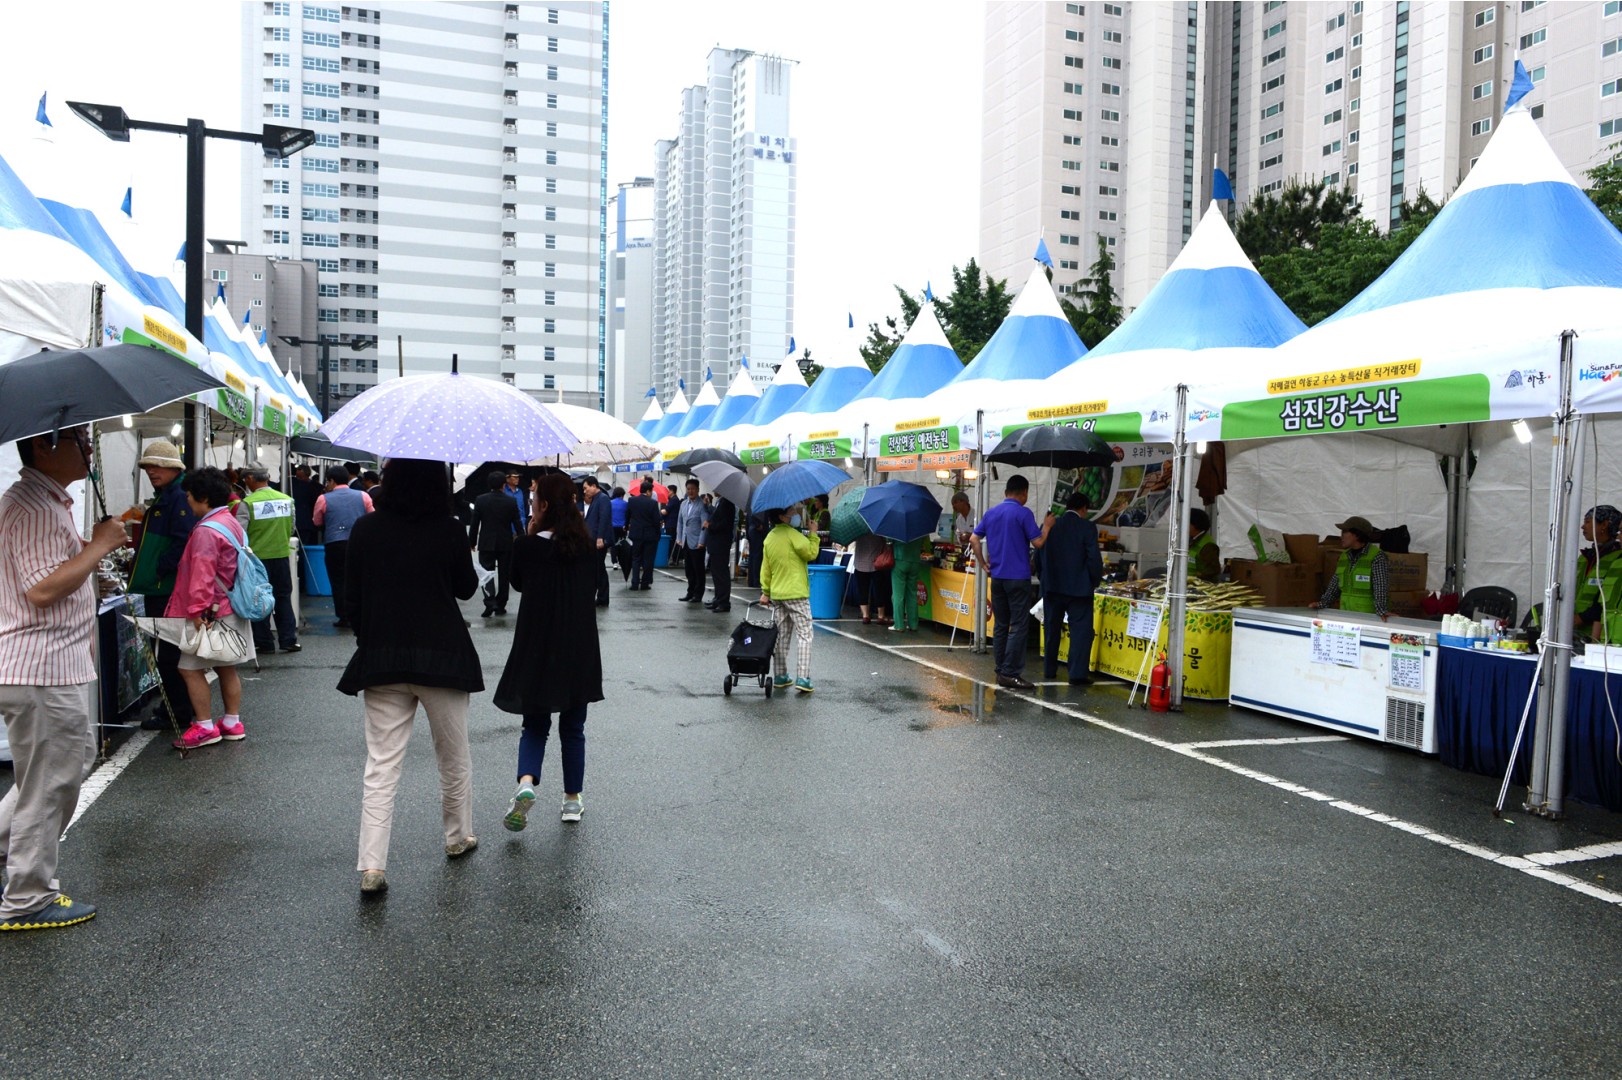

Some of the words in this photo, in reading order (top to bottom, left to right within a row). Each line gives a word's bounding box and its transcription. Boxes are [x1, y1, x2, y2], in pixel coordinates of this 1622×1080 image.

[1299, 376, 1320, 387] 하동군
[1322, 374, 1337, 385] 우수
[1340, 368, 1371, 383] 농특산물
[1374, 362, 1417, 377] 직거래장터
[1281, 387, 1400, 430] 섬진강수산
[1103, 628, 1124, 650] 청정
